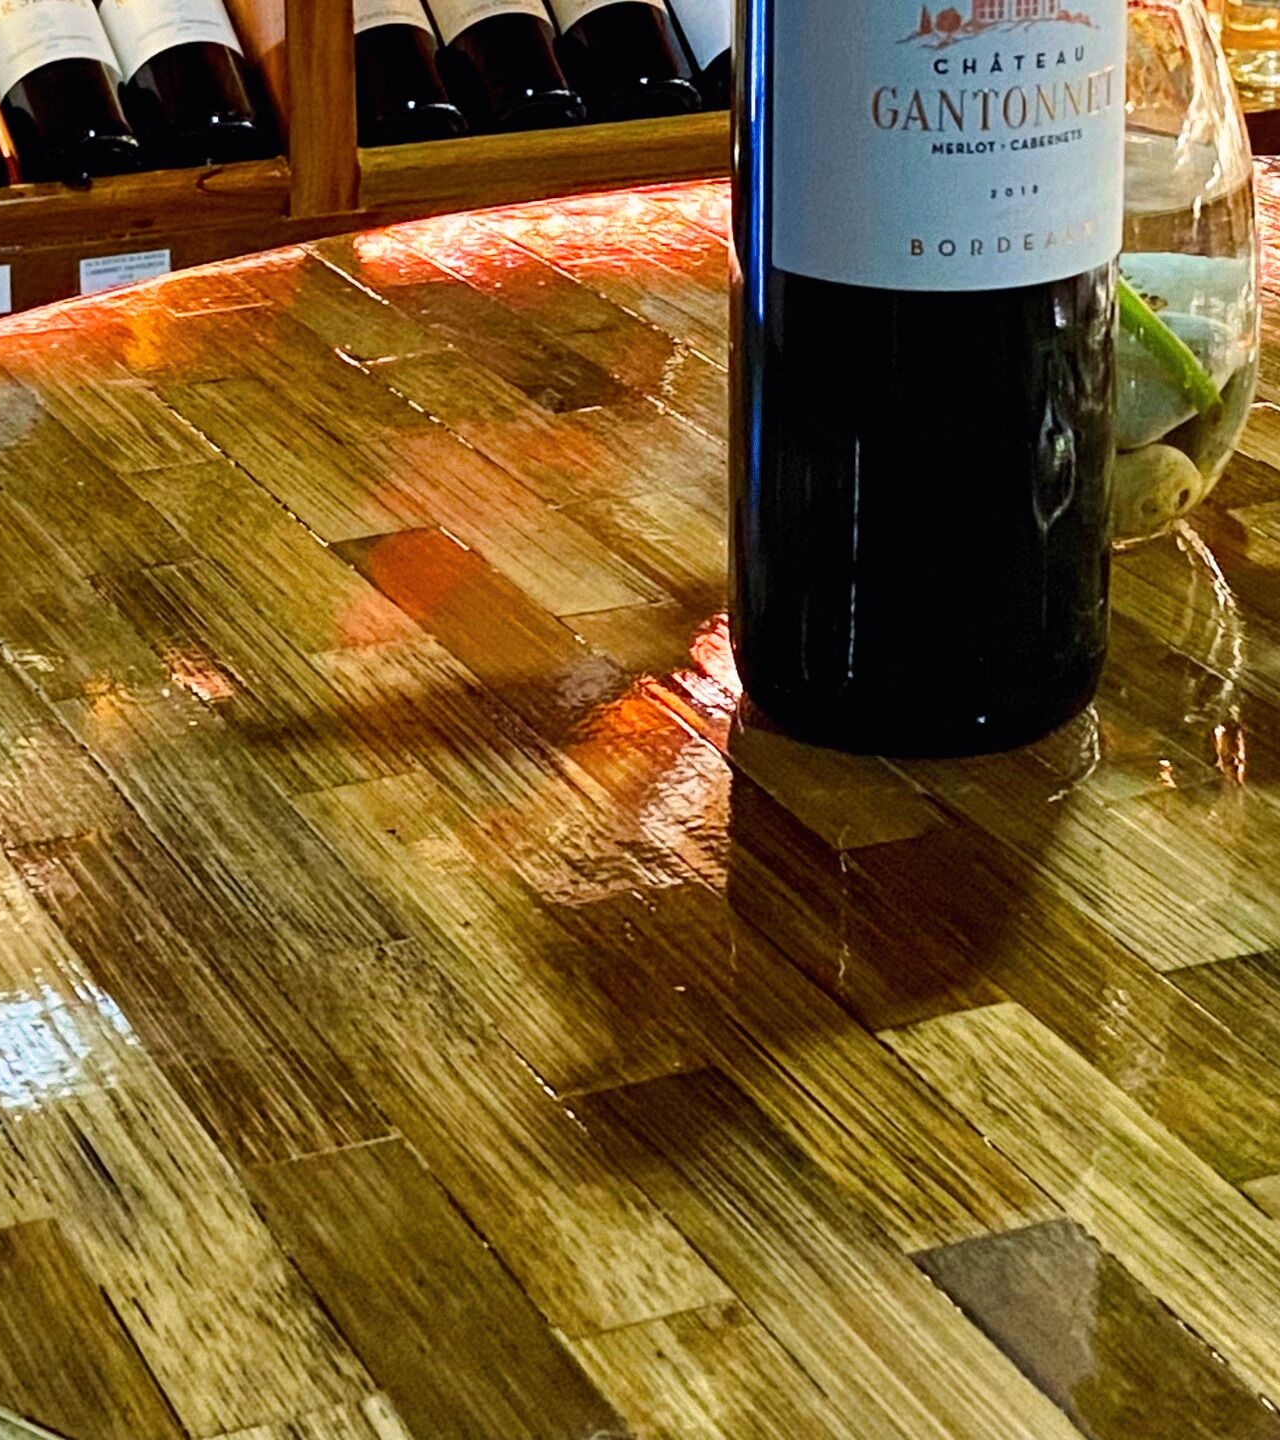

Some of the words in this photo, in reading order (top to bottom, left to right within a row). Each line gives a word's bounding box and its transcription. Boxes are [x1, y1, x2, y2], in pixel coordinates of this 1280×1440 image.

[933, 46, 1085, 75] CHÂTEAU
[871, 65, 1116, 132] GANTONNET
[931, 141, 996, 155] MERLOT
